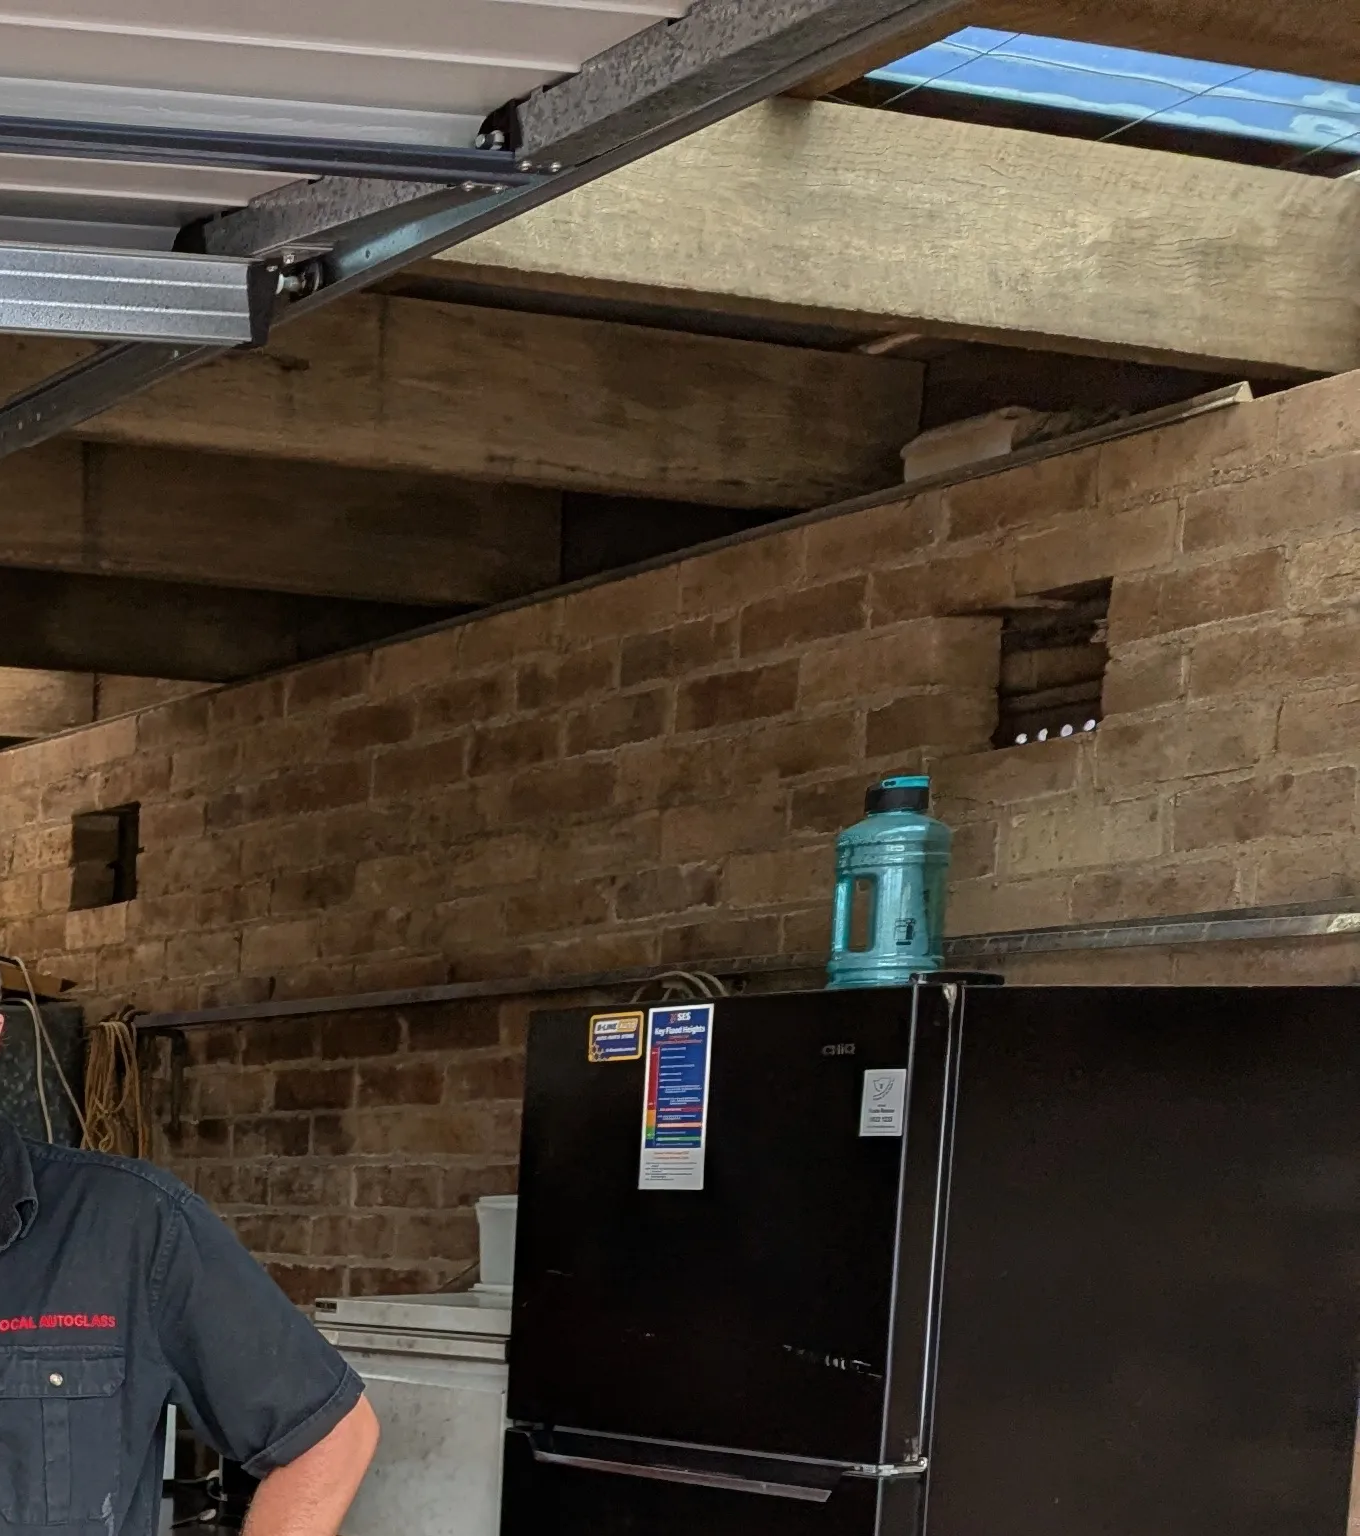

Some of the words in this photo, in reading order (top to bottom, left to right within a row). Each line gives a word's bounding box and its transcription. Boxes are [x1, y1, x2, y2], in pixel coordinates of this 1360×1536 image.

[655, 1028, 666, 1036] Key
[683, 1025, 705, 1035] Heights
[39, 1315, 116, 1328] AUTOGLASS
